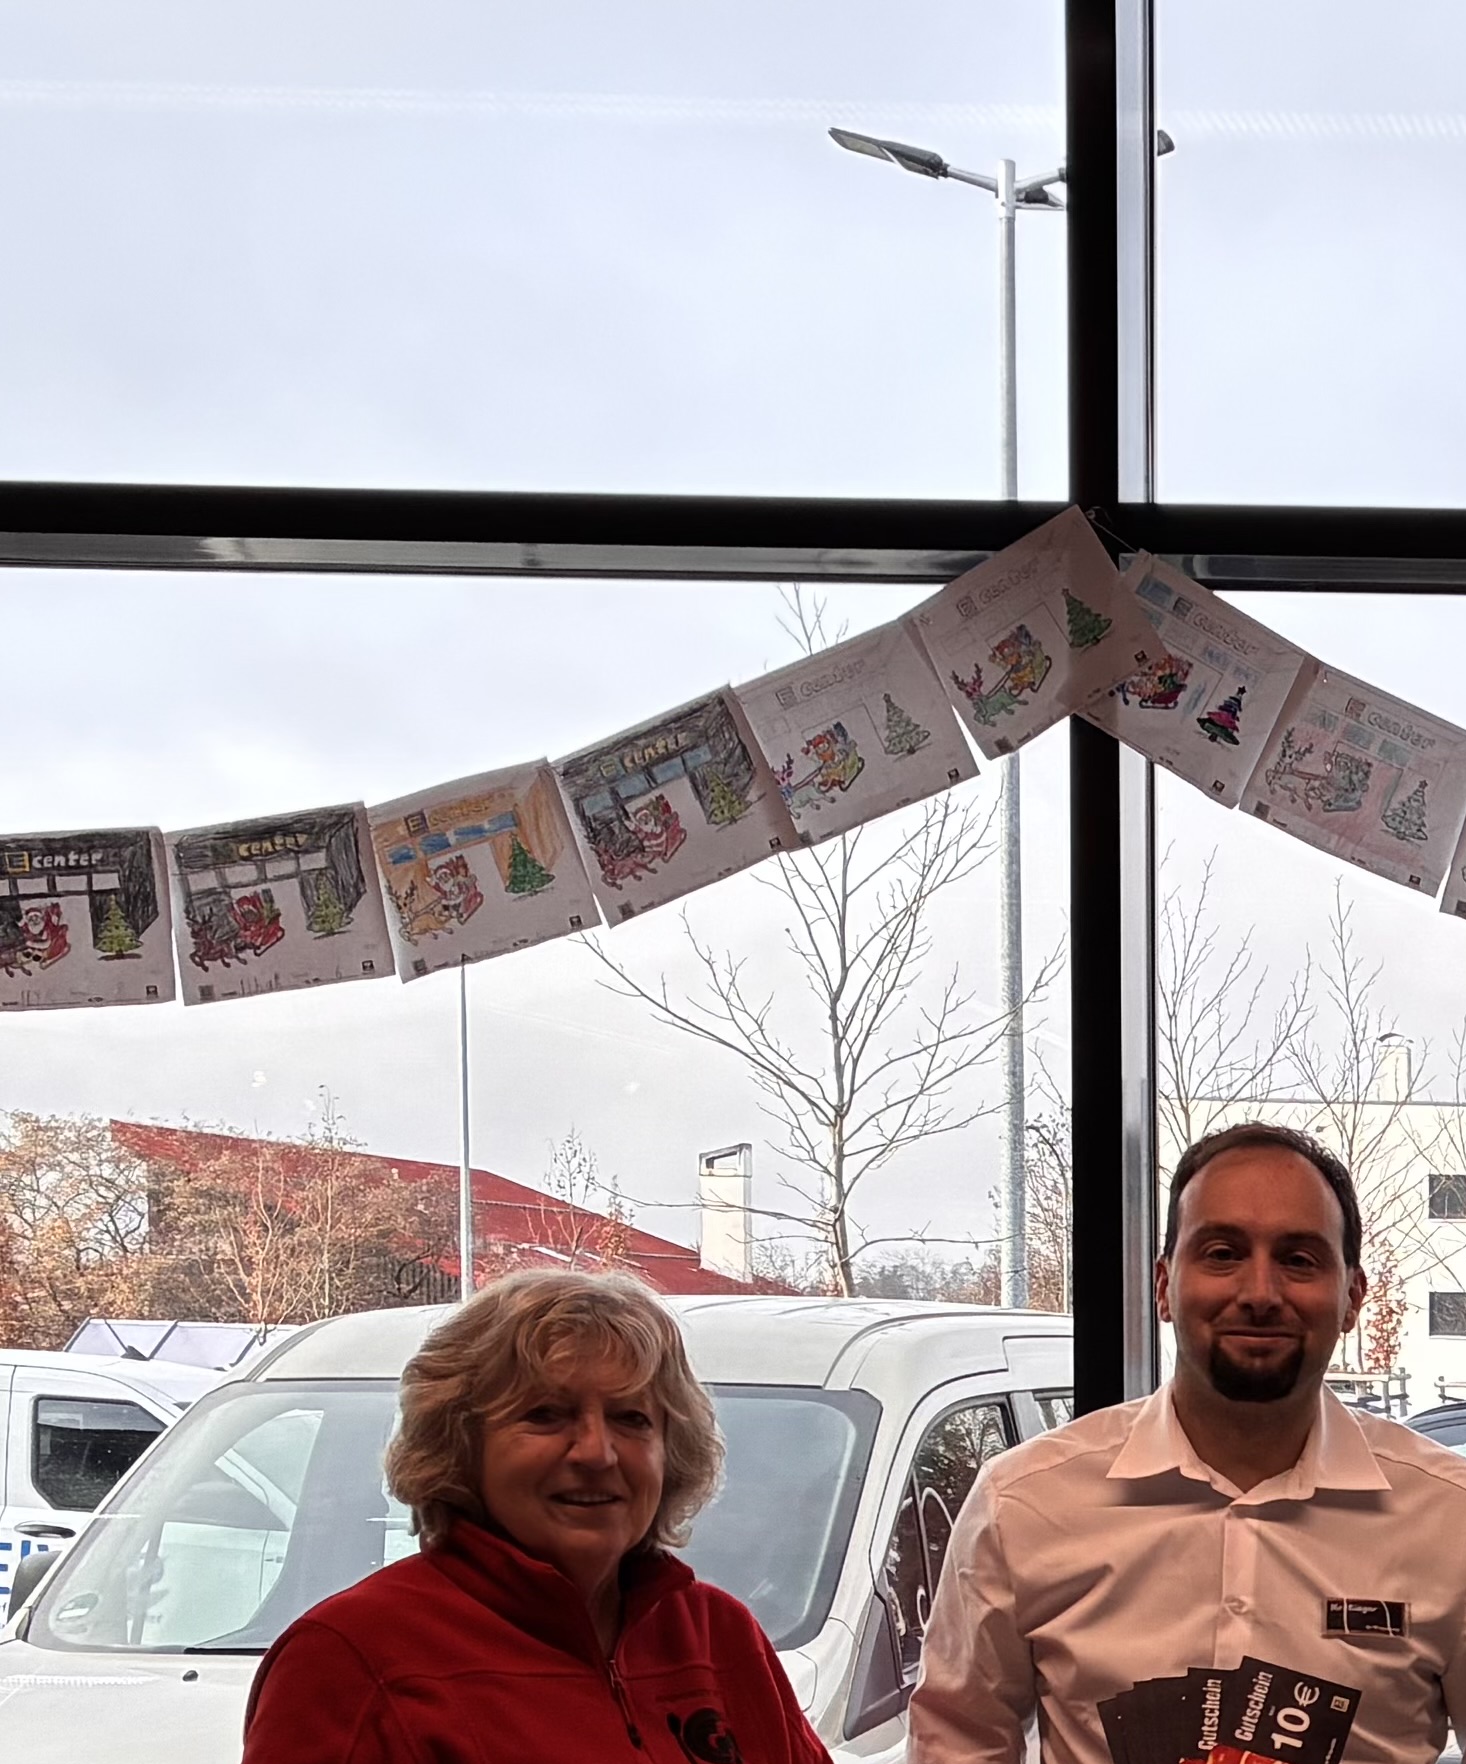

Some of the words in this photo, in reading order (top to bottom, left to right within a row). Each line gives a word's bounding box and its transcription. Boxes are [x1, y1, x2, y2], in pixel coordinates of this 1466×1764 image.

[32, 851, 103, 869] center
[1197, 1678, 1222, 1750] Gutschein
[1234, 1671, 1273, 1742] Gutschein
